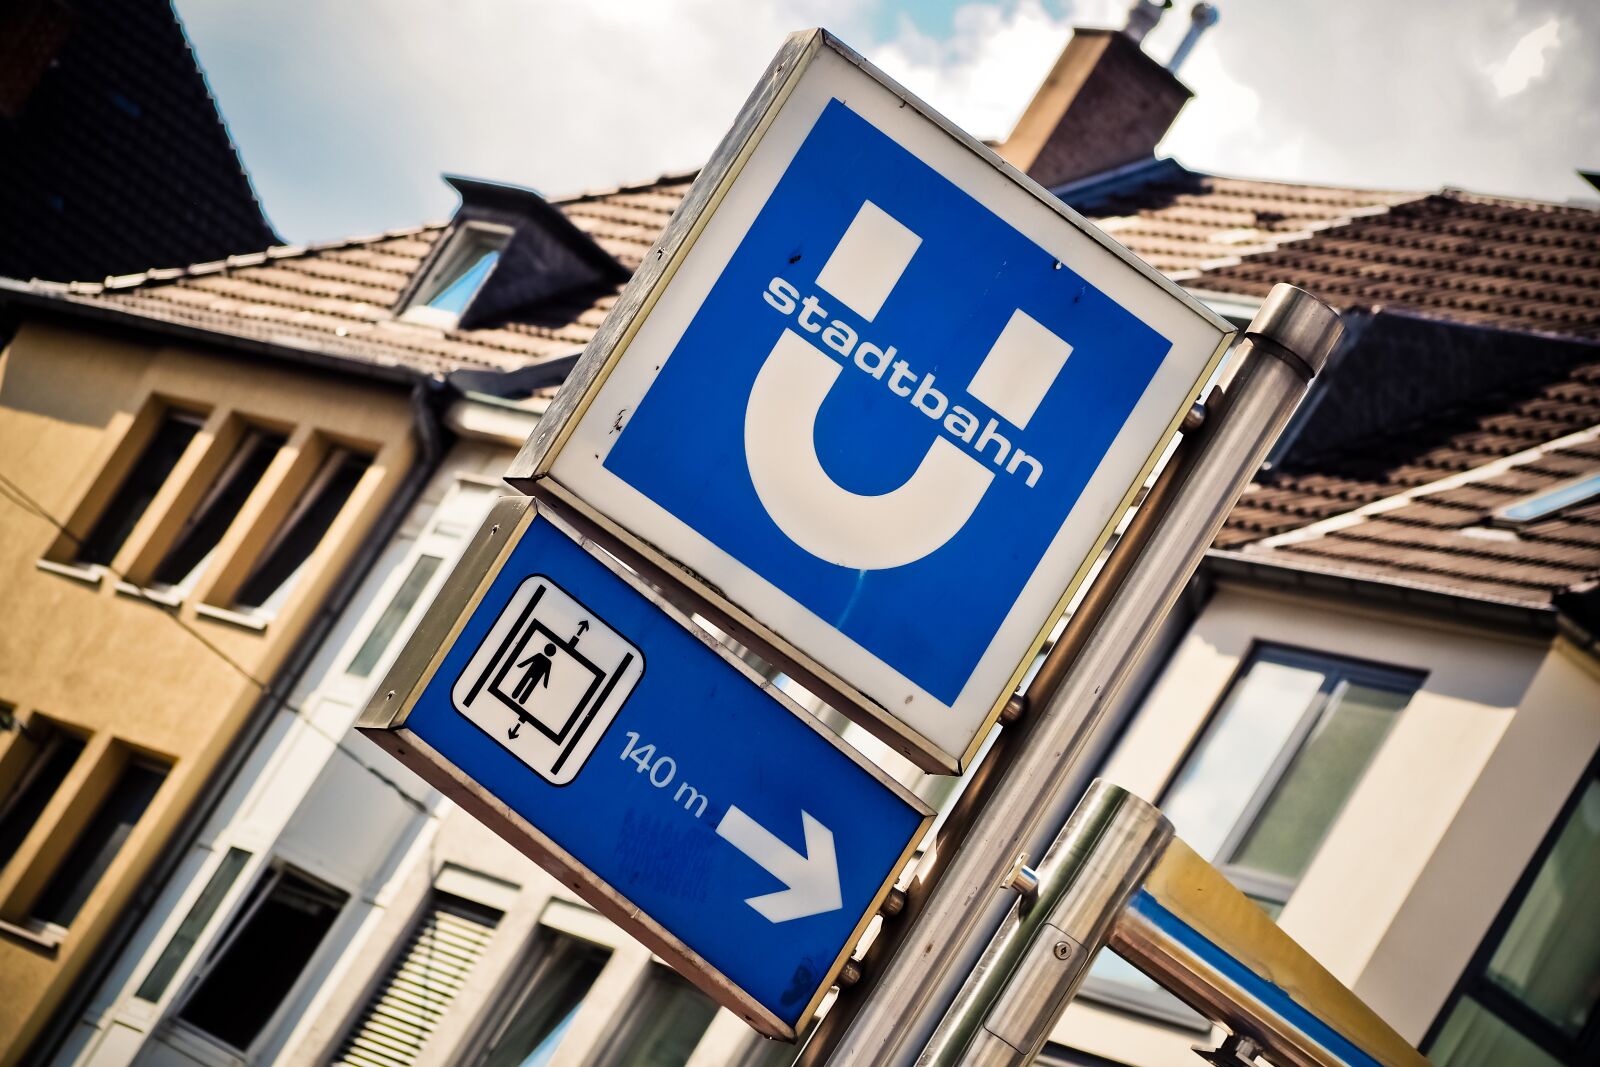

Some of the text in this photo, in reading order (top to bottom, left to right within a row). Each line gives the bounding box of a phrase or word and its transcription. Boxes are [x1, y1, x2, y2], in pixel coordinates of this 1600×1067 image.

[763, 276, 1044, 488] stadtbahn
[619, 731, 708, 818] 140 m
